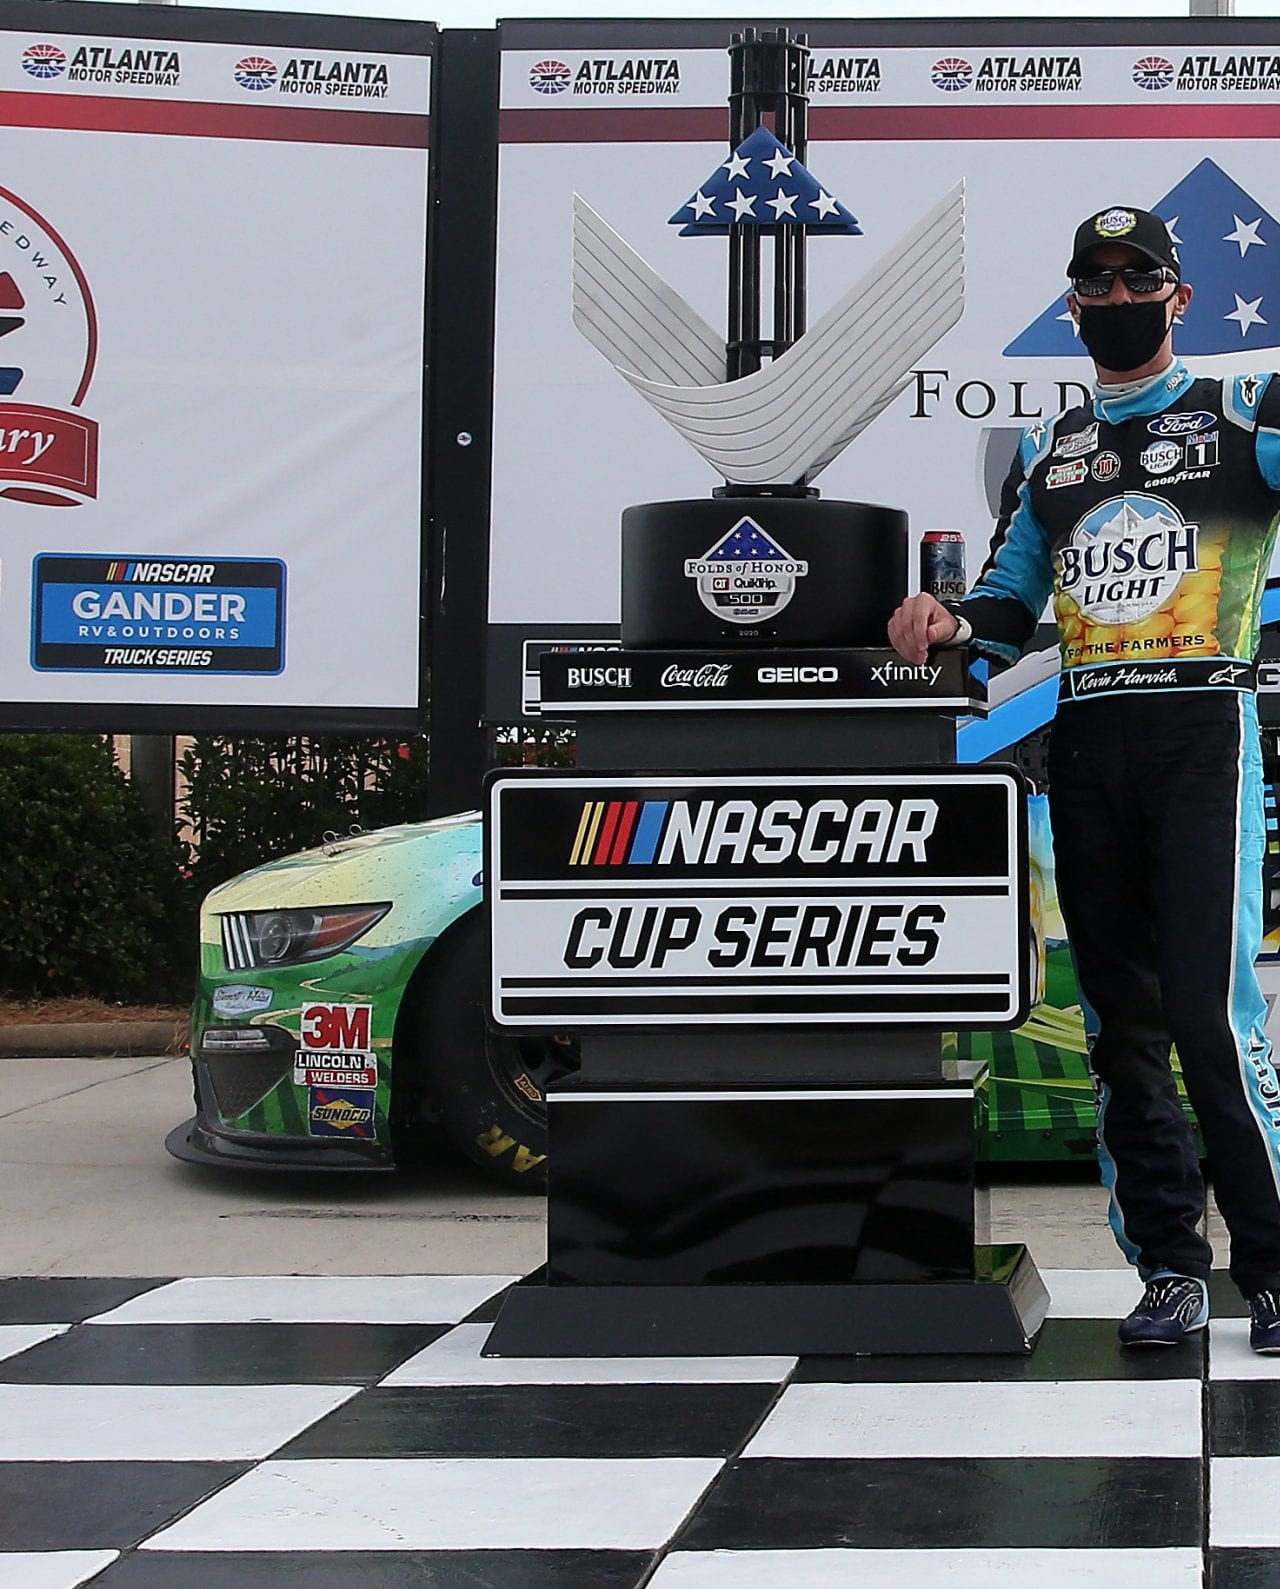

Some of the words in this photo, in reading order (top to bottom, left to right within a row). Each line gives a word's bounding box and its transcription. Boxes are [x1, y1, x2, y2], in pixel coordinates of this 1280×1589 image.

[72, 46, 181, 73] ATLANTA
[806, 58, 880, 79] LANTA
[979, 57, 1082, 78] ATLANTA
[68, 66, 111, 83] MOTOR
[115, 69, 180, 87] SPEEDWAY
[283, 59, 388, 84] ATLANTA
[576, 60, 680, 81] ATLANTA
[279, 79, 321, 95] MOTOR
[325, 80, 388, 98] SPEEDWAY
[573, 80, 614, 95] MOTOR
[617, 80, 679, 94] SPEEDWAY
[819, 78, 880, 92] SPEEDWAY
[975, 77, 1016, 92] MOTOR
[1020, 77, 1081, 91] SPEEDWAY
[1177, 77, 1218, 90] MOTOR
[0, 221, 67, 305] EDWAY
[909, 370, 1092, 419] FOLD
[1159, 413, 1203, 433] Ford
[1141, 447, 1183, 466] BUSCH
[1195, 443, 1206, 465] 1
[1144, 470, 1210, 489] GOODYEAR
[1060, 527, 1199, 589] BUSCH
[132, 563, 215, 583] NASCAR
[687, 562, 733, 574] FOLDS
[736, 562, 748, 575] of
[752, 562, 804, 573] HONOR
[729, 594, 763, 604] 500
[1084, 576, 1165, 606] LIGHT
[72, 591, 246, 622] GANDER
[1088, 642, 1115, 654] THE
[1121, 635, 1206, 651] FARMERS
[104, 649, 156, 665] TRUCK
[158, 650, 212, 666] SERIES
[567, 667, 632, 688] BUSCH
[660, 664, 733, 688] Coca-Cola
[757, 667, 840, 683] GEICO
[871, 662, 943, 686] xfinity
[1077, 671, 1112, 691] Kevin
[658, 800, 939, 864] NASCAR
[563, 907, 703, 970] CUP
[707, 905, 947, 969] SERIES
[303, 1006, 370, 1049] 3M
[298, 1054, 362, 1069] LINCOLN
[311, 1072, 369, 1084] WELDERS
[313, 1107, 370, 1121] SUNOCO
